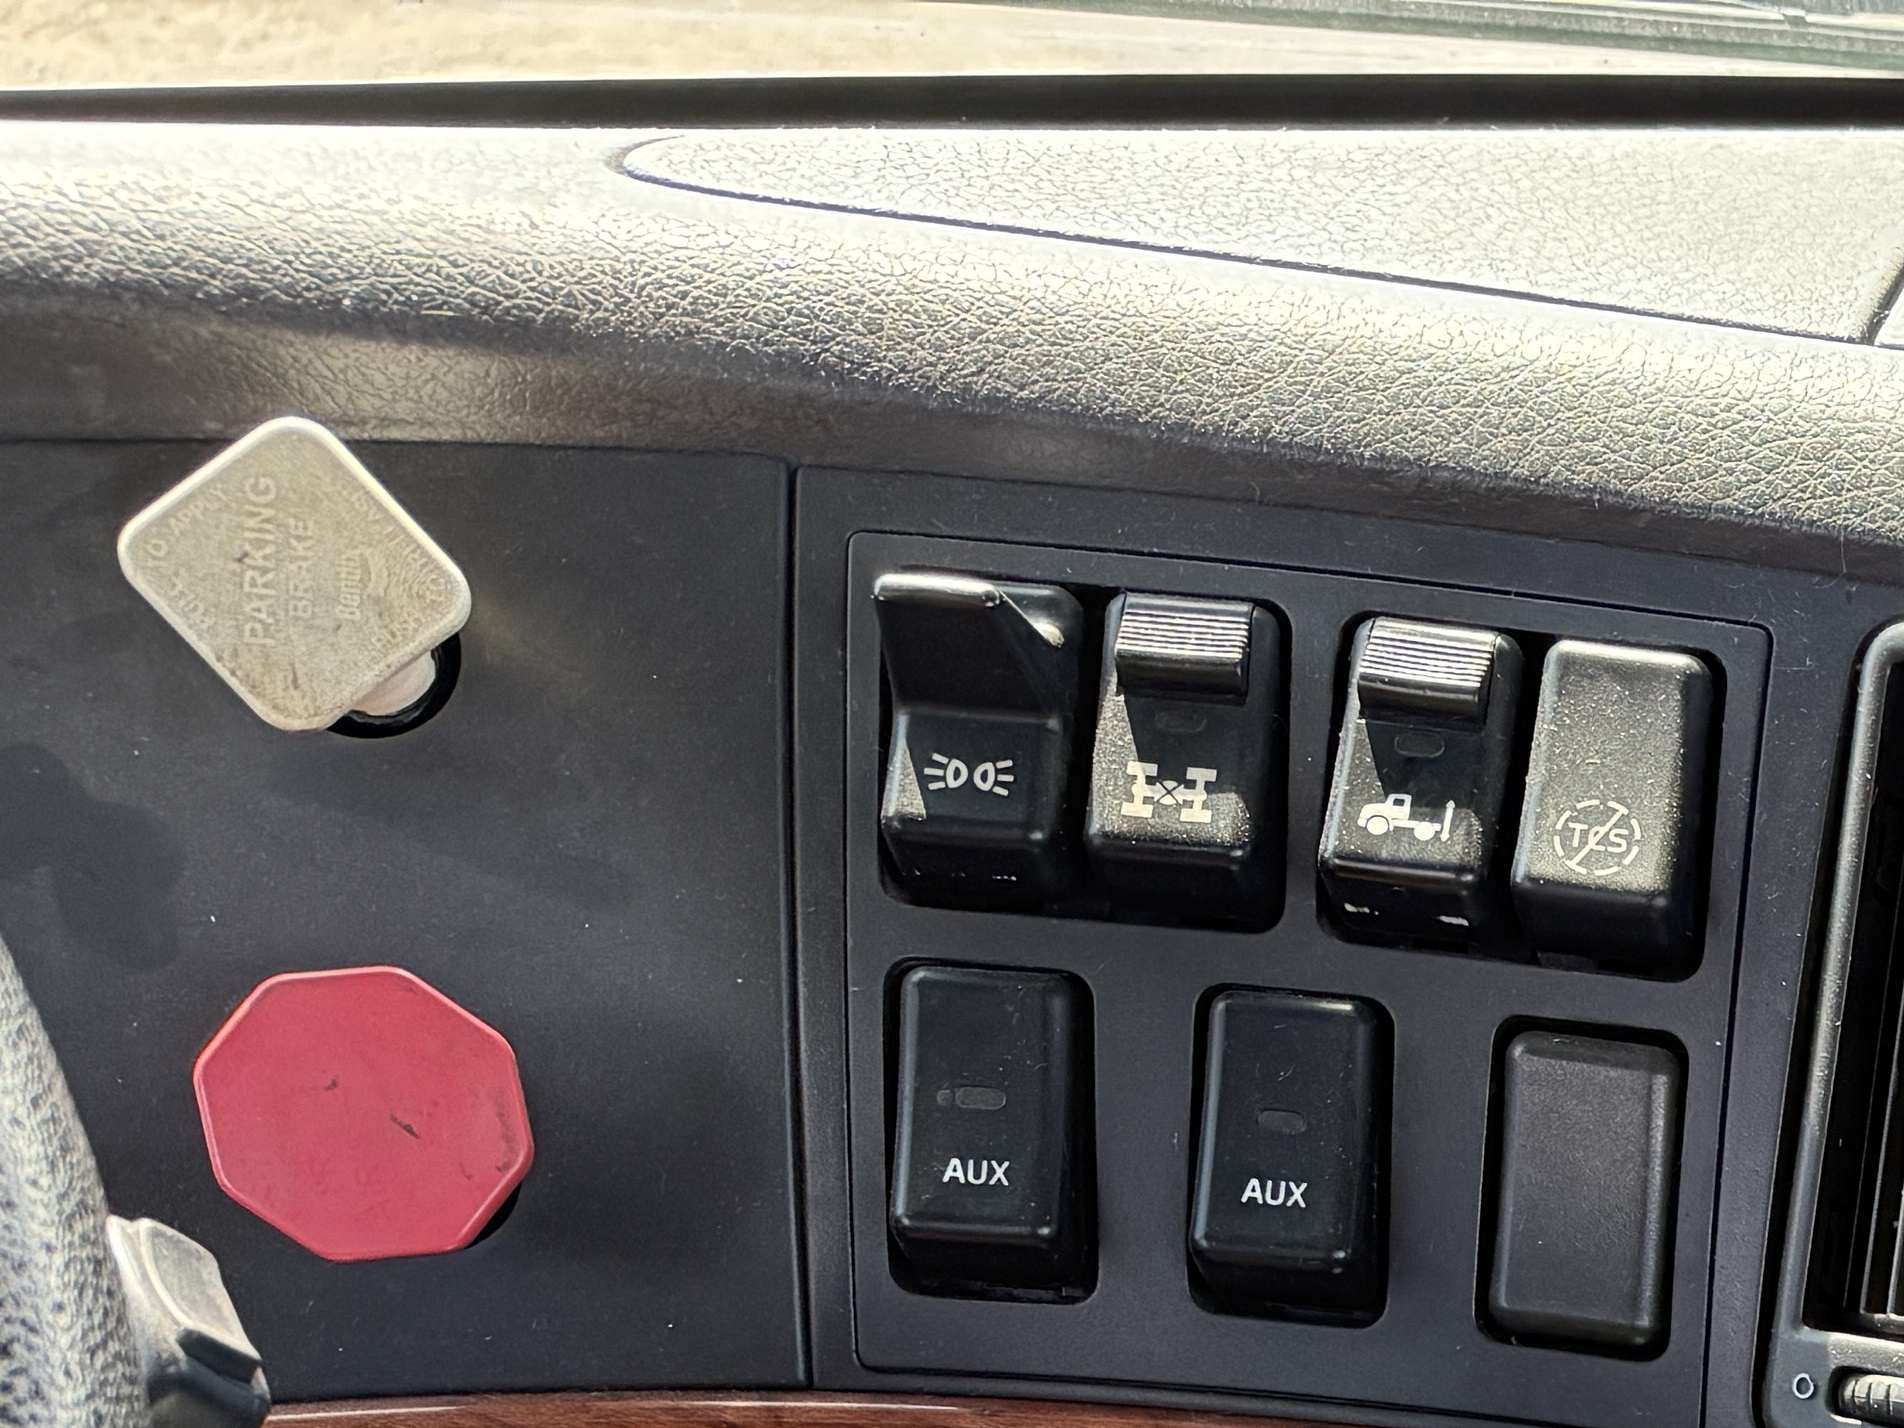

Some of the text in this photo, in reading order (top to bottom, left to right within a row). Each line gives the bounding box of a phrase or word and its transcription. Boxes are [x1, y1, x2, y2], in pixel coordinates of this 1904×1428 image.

[243, 476, 278, 646] PARKING
[288, 517, 314, 618] BRAKE
[1567, 821, 1629, 853] TCS
[941, 1156, 1010, 1187] AUX
[1240, 1177, 1308, 1209] AUX
